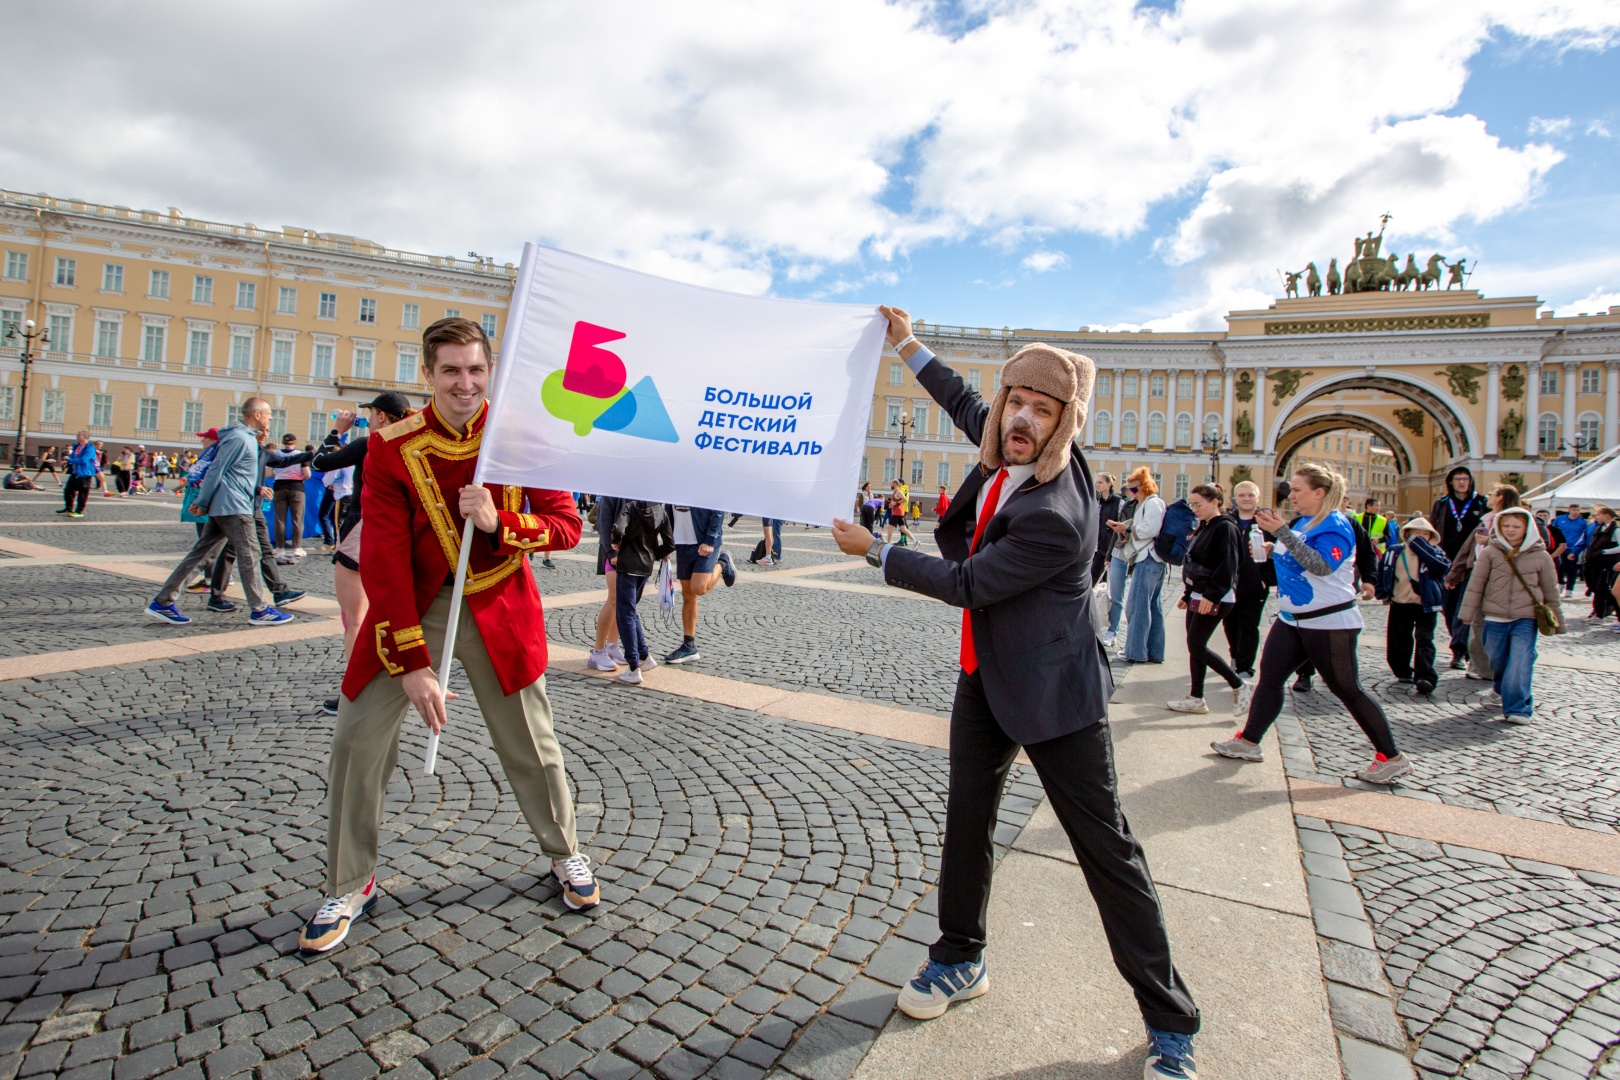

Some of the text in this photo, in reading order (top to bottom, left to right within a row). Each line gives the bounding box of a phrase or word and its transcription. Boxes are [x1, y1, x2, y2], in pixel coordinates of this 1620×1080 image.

[703, 386, 813, 411] БОЛЬШОЙ
[697, 410, 797, 433] ДЕТСКИЙ
[693, 432, 823, 456] ФЕСТИВАЛЬ
